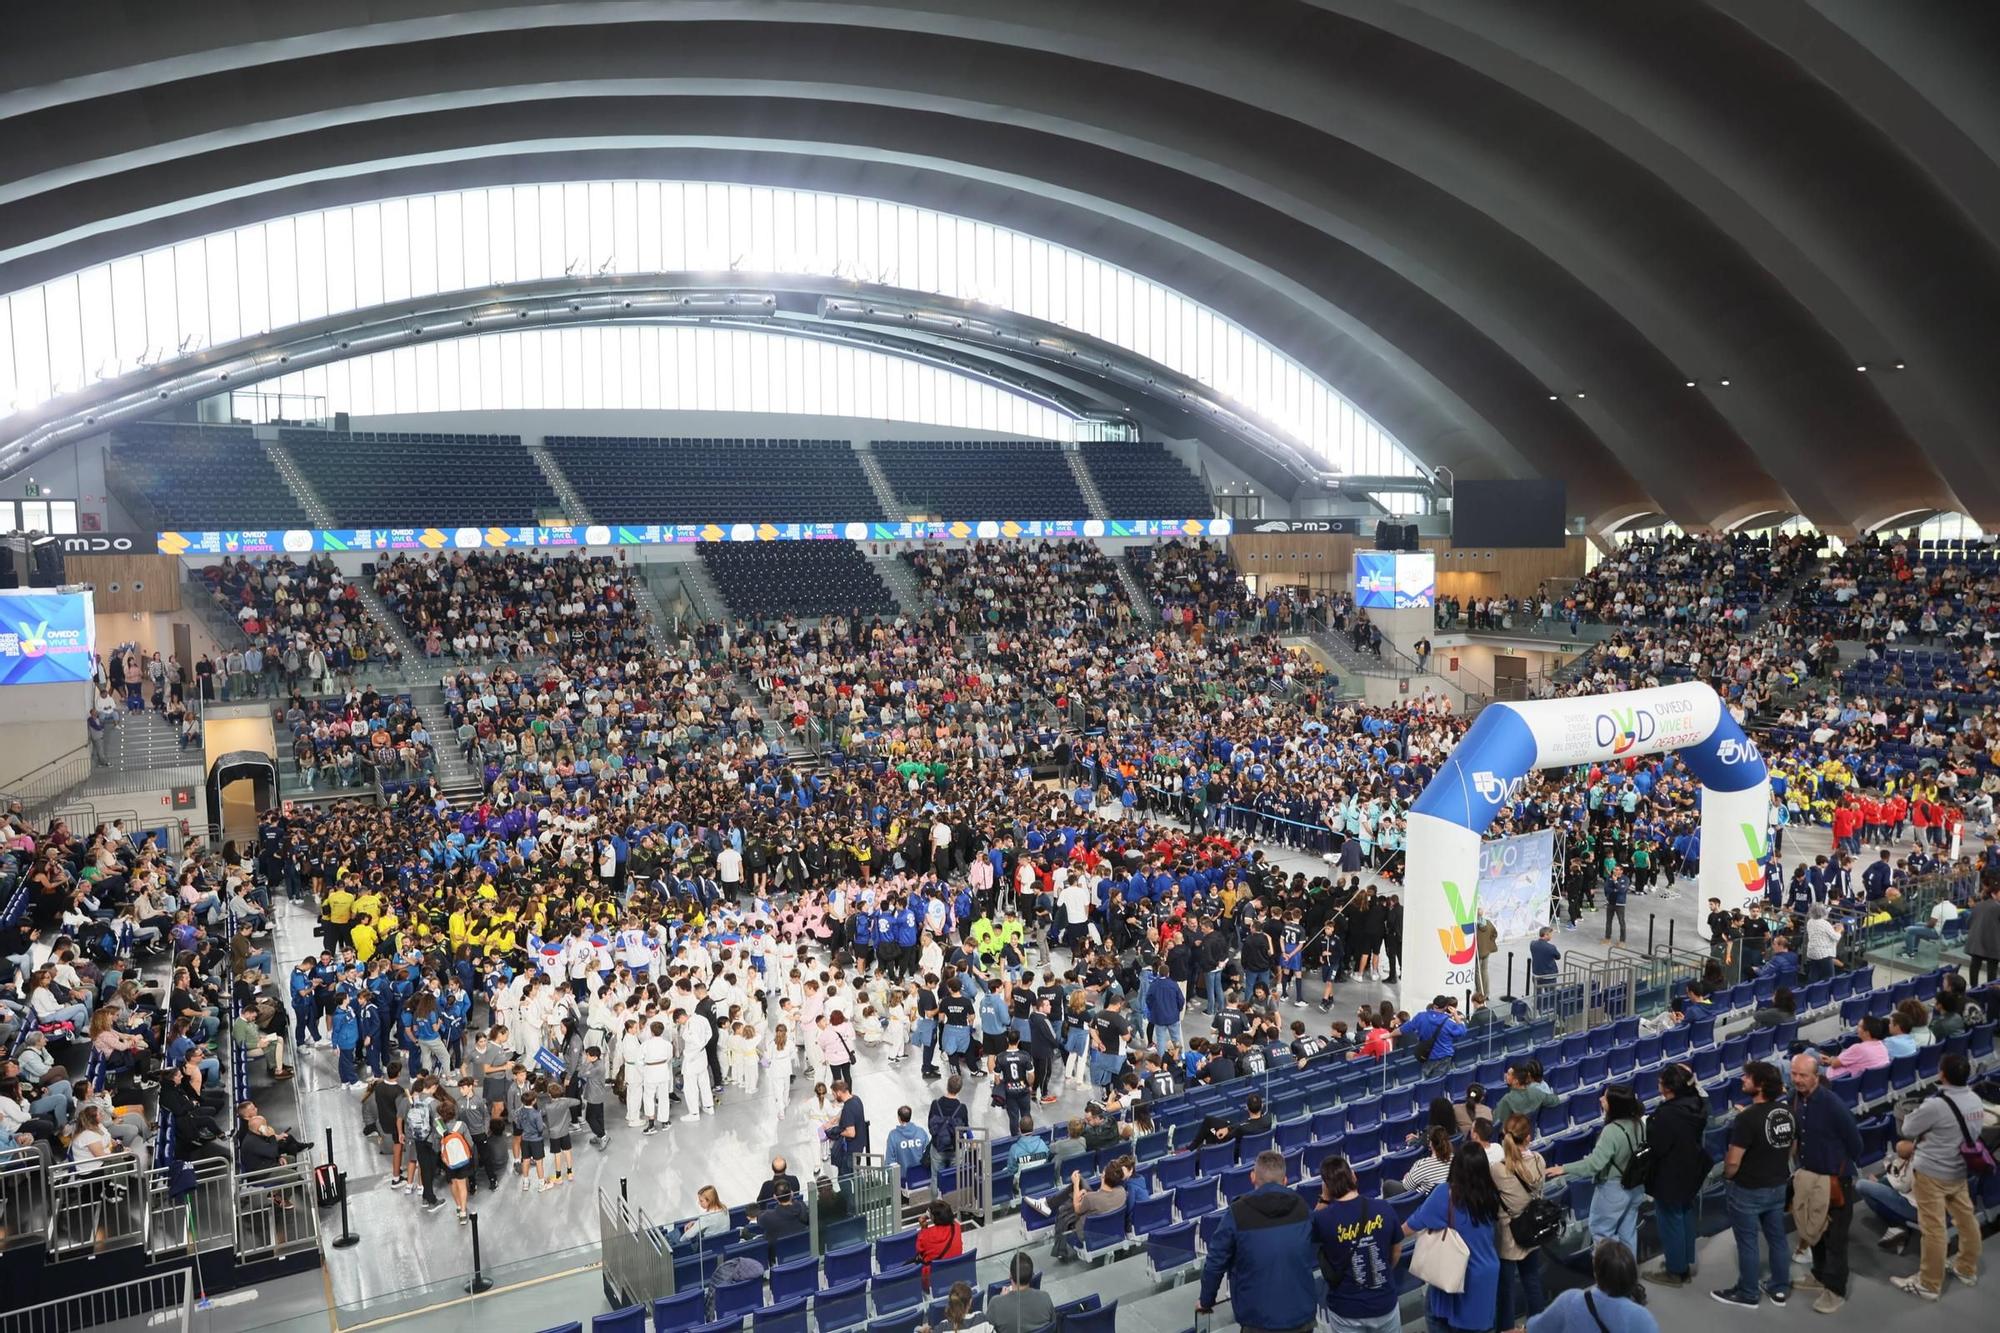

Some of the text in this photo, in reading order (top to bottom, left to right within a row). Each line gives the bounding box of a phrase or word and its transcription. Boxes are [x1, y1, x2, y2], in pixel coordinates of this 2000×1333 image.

[1292, 522, 1343, 531] PMDO
[58, 537, 133, 550] MDO
[243, 544, 273, 552] DEPORTE
[47, 630, 79, 639] OVIEDO
[1654, 700, 1693, 716] OVIEDO
[1659, 717, 1693, 734] VIVE EL
[1652, 731, 1701, 749] DEPORTE
[1224, 1018, 1231, 1034] 6
[1010, 1064, 1018, 1080] 6
[1156, 1077, 1174, 1095] 77
[1773, 1122, 1791, 1135] VANS
[900, 1138, 922, 1148] ORC
